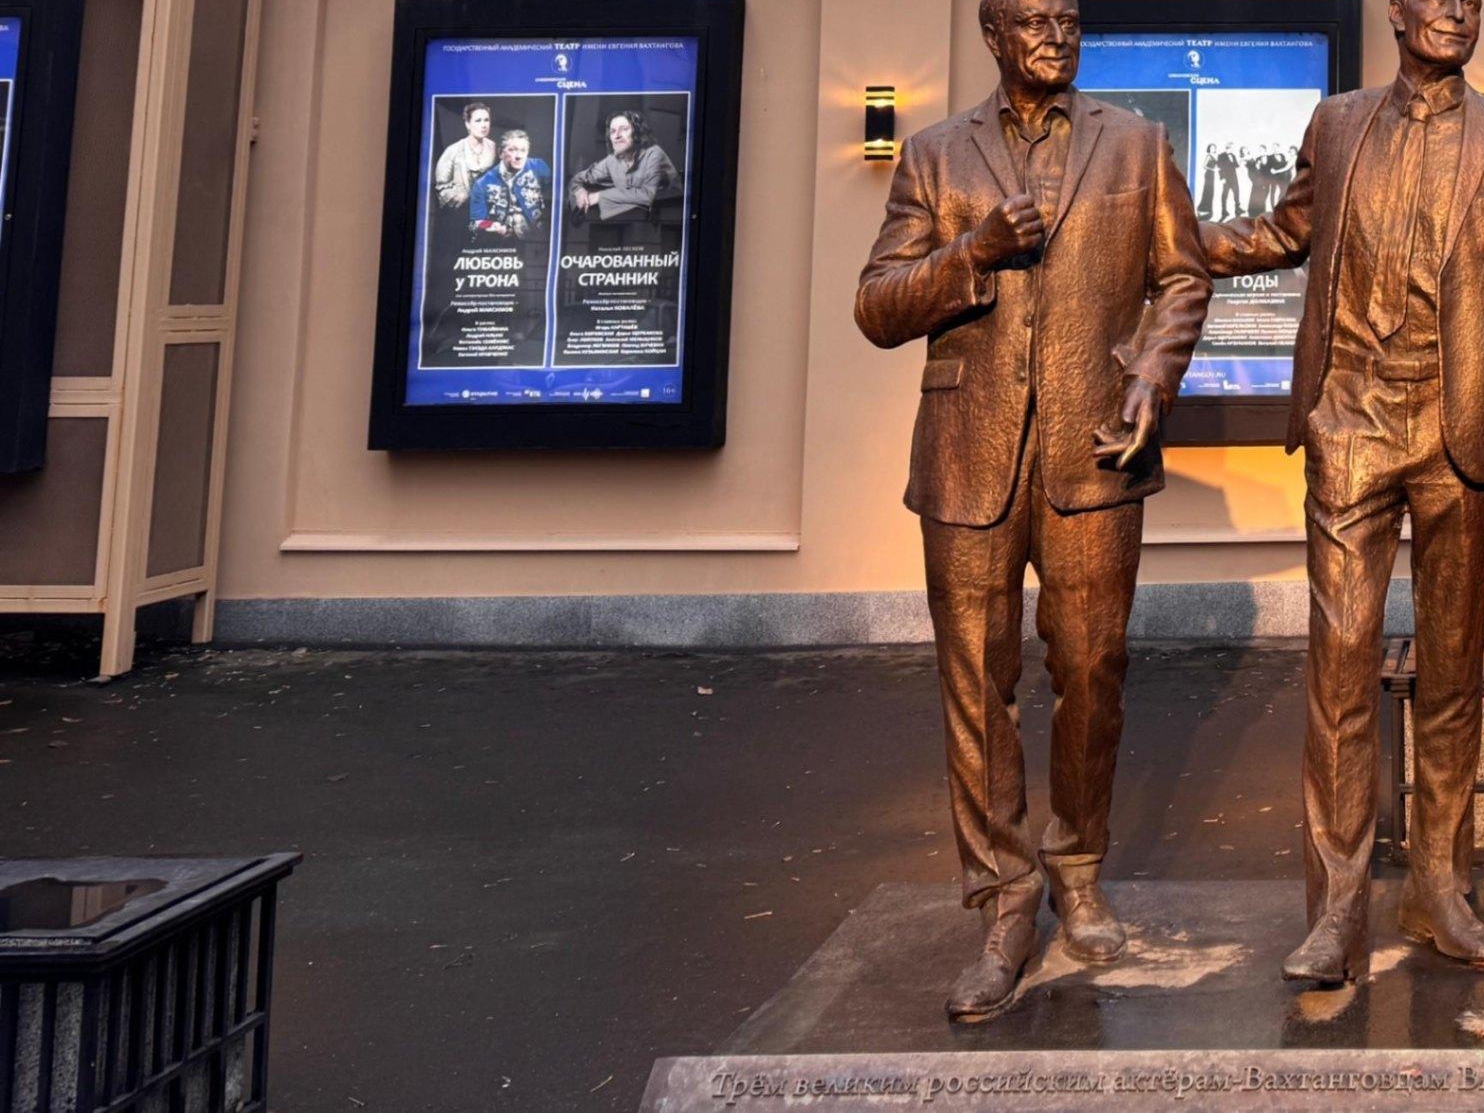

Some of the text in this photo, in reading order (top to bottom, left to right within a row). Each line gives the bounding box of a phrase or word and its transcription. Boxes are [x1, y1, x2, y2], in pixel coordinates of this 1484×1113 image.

[453, 256, 524, 270] ЛЮБОВЬ
[560, 251, 680, 269] ОЧАРОВАННЫЙ
[455, 274, 520, 292] у ТРОНА
[578, 272, 659, 286] СТРАННИК
[1232, 275, 1279, 291] ГОДЫ
[711, 1072, 785, 1106] Трём
[793, 1074, 920, 1096] великим
[922, 1066, 1104, 1102] российским
[1113, 1066, 1451, 1100] актёрам-Вахтанговцам
